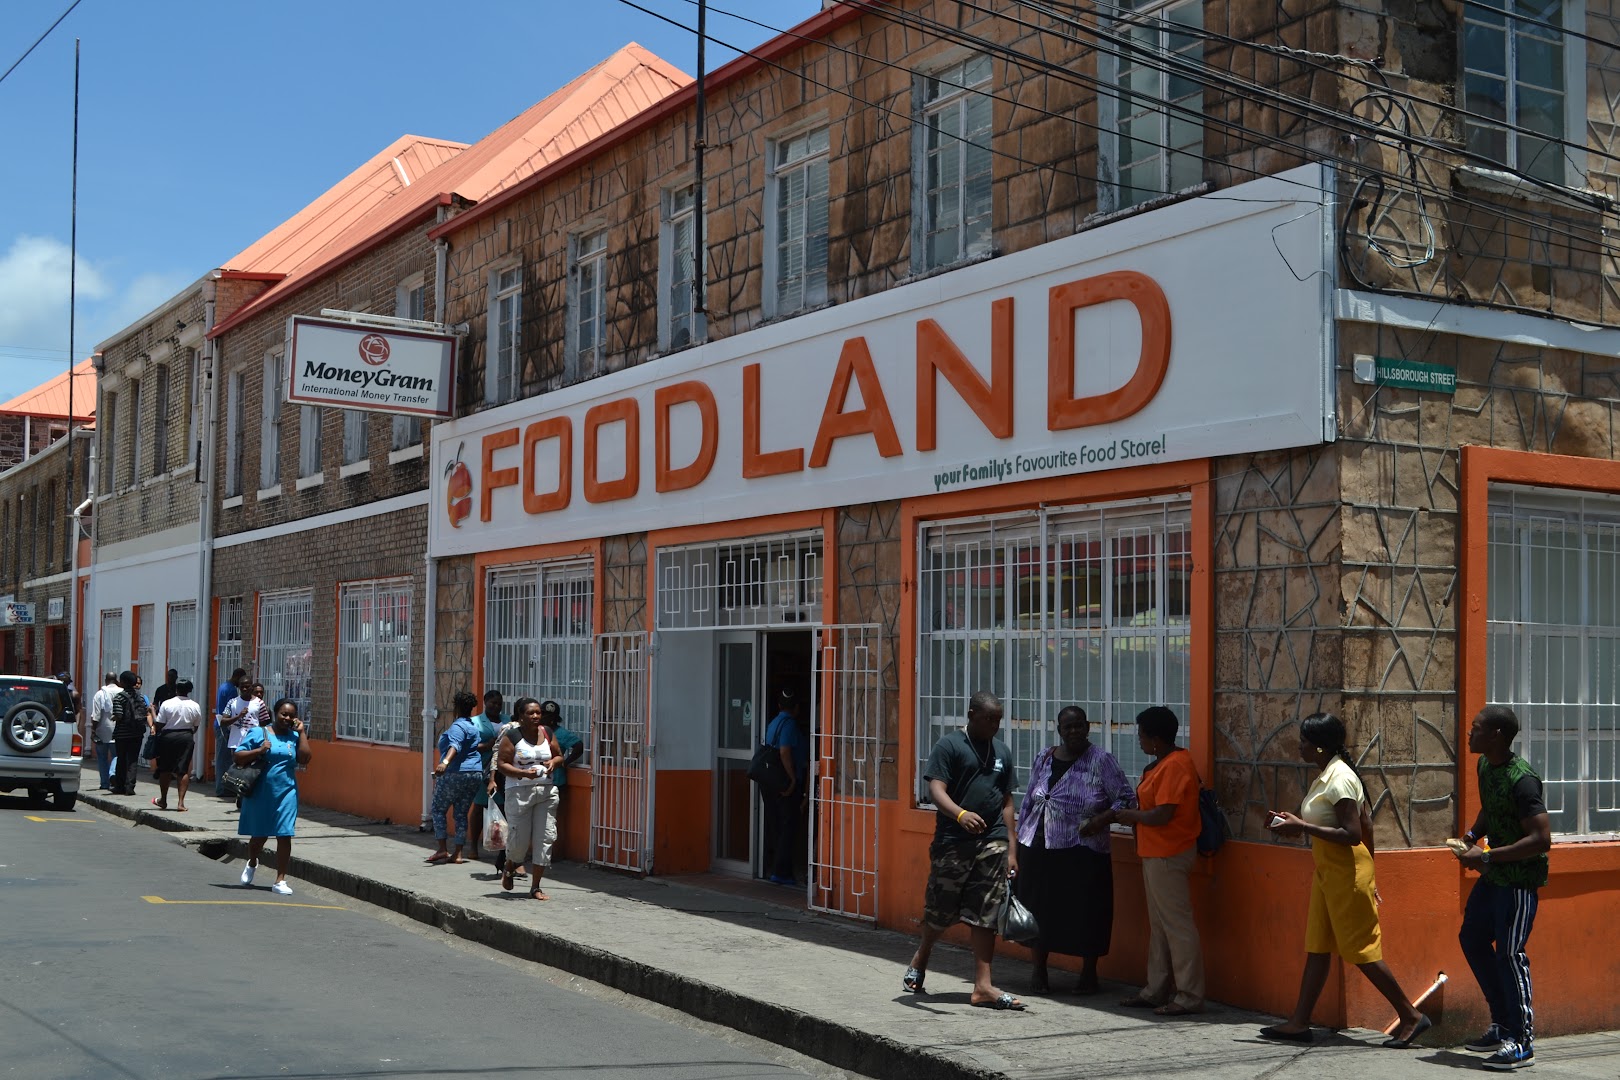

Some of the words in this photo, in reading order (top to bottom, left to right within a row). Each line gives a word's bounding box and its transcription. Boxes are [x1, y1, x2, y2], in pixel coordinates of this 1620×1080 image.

[303, 360, 433, 391] MoneyGram
[1376, 367, 1429, 383] HILLSBOROUGH
[1430, 373, 1455, 385] STREET
[301, 383, 358, 398] International
[360, 390, 390, 403] Money
[393, 393, 429, 404] Transfer
[480, 269, 1172, 522] FOODLAND
[934, 470, 962, 492] your
[1016, 450, 1078, 474] Favourite
[1120, 433, 1166, 459] Store!
